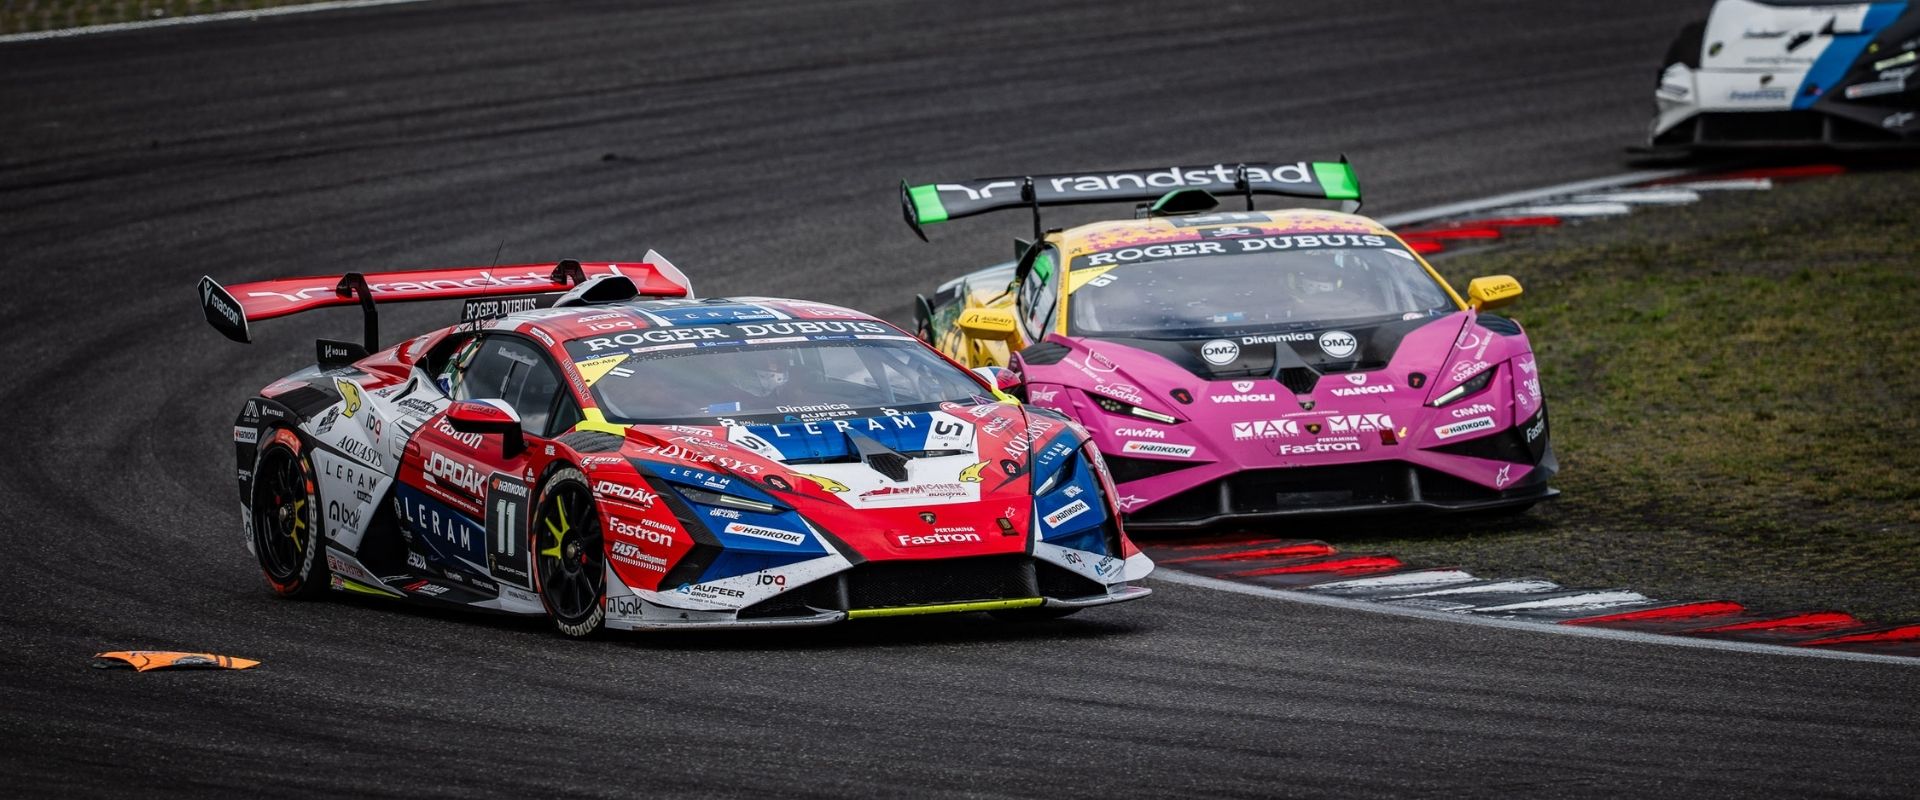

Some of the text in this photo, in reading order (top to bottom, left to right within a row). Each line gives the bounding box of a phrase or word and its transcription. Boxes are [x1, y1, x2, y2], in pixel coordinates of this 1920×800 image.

[1088, 235, 1386, 266] ROGER DUBUIS
[211, 294, 239, 325] macron
[466, 297, 536, 320] ROGER DUBUIS
[584, 321, 886, 351] ROGER DUBUIS
[1242, 333, 1315, 345] Dinamica
[582, 358, 617, 368] PRO-AM
[1211, 394, 1276, 404] VANOLI
[1331, 385, 1395, 397] VANOLI
[776, 403, 850, 414] Dinamica
[771, 415, 916, 438] LERAM
[1232, 420, 1299, 438] MAC
[1327, 414, 1393, 432] MAC
[336, 435, 382, 467] AQUASYS
[1280, 443, 1360, 455] Fastron
[643, 442, 764, 475] AQUASYS
[326, 460, 377, 489] LERAM
[670, 468, 731, 485] LERAM
[498, 480, 527, 497] Hankook
[405, 497, 470, 551] LERAM
[496, 499, 516, 556] 11
[609, 517, 673, 547] Fastron
[641, 518, 676, 533] PERTAMINA
[744, 527, 800, 543] Hankook
[898, 533, 981, 546] Fastron
[612, 541, 638, 557] FAST
[636, 550, 667, 567] Development
[690, 591, 717, 599] GROUP
[693, 584, 745, 599] AUFEER
